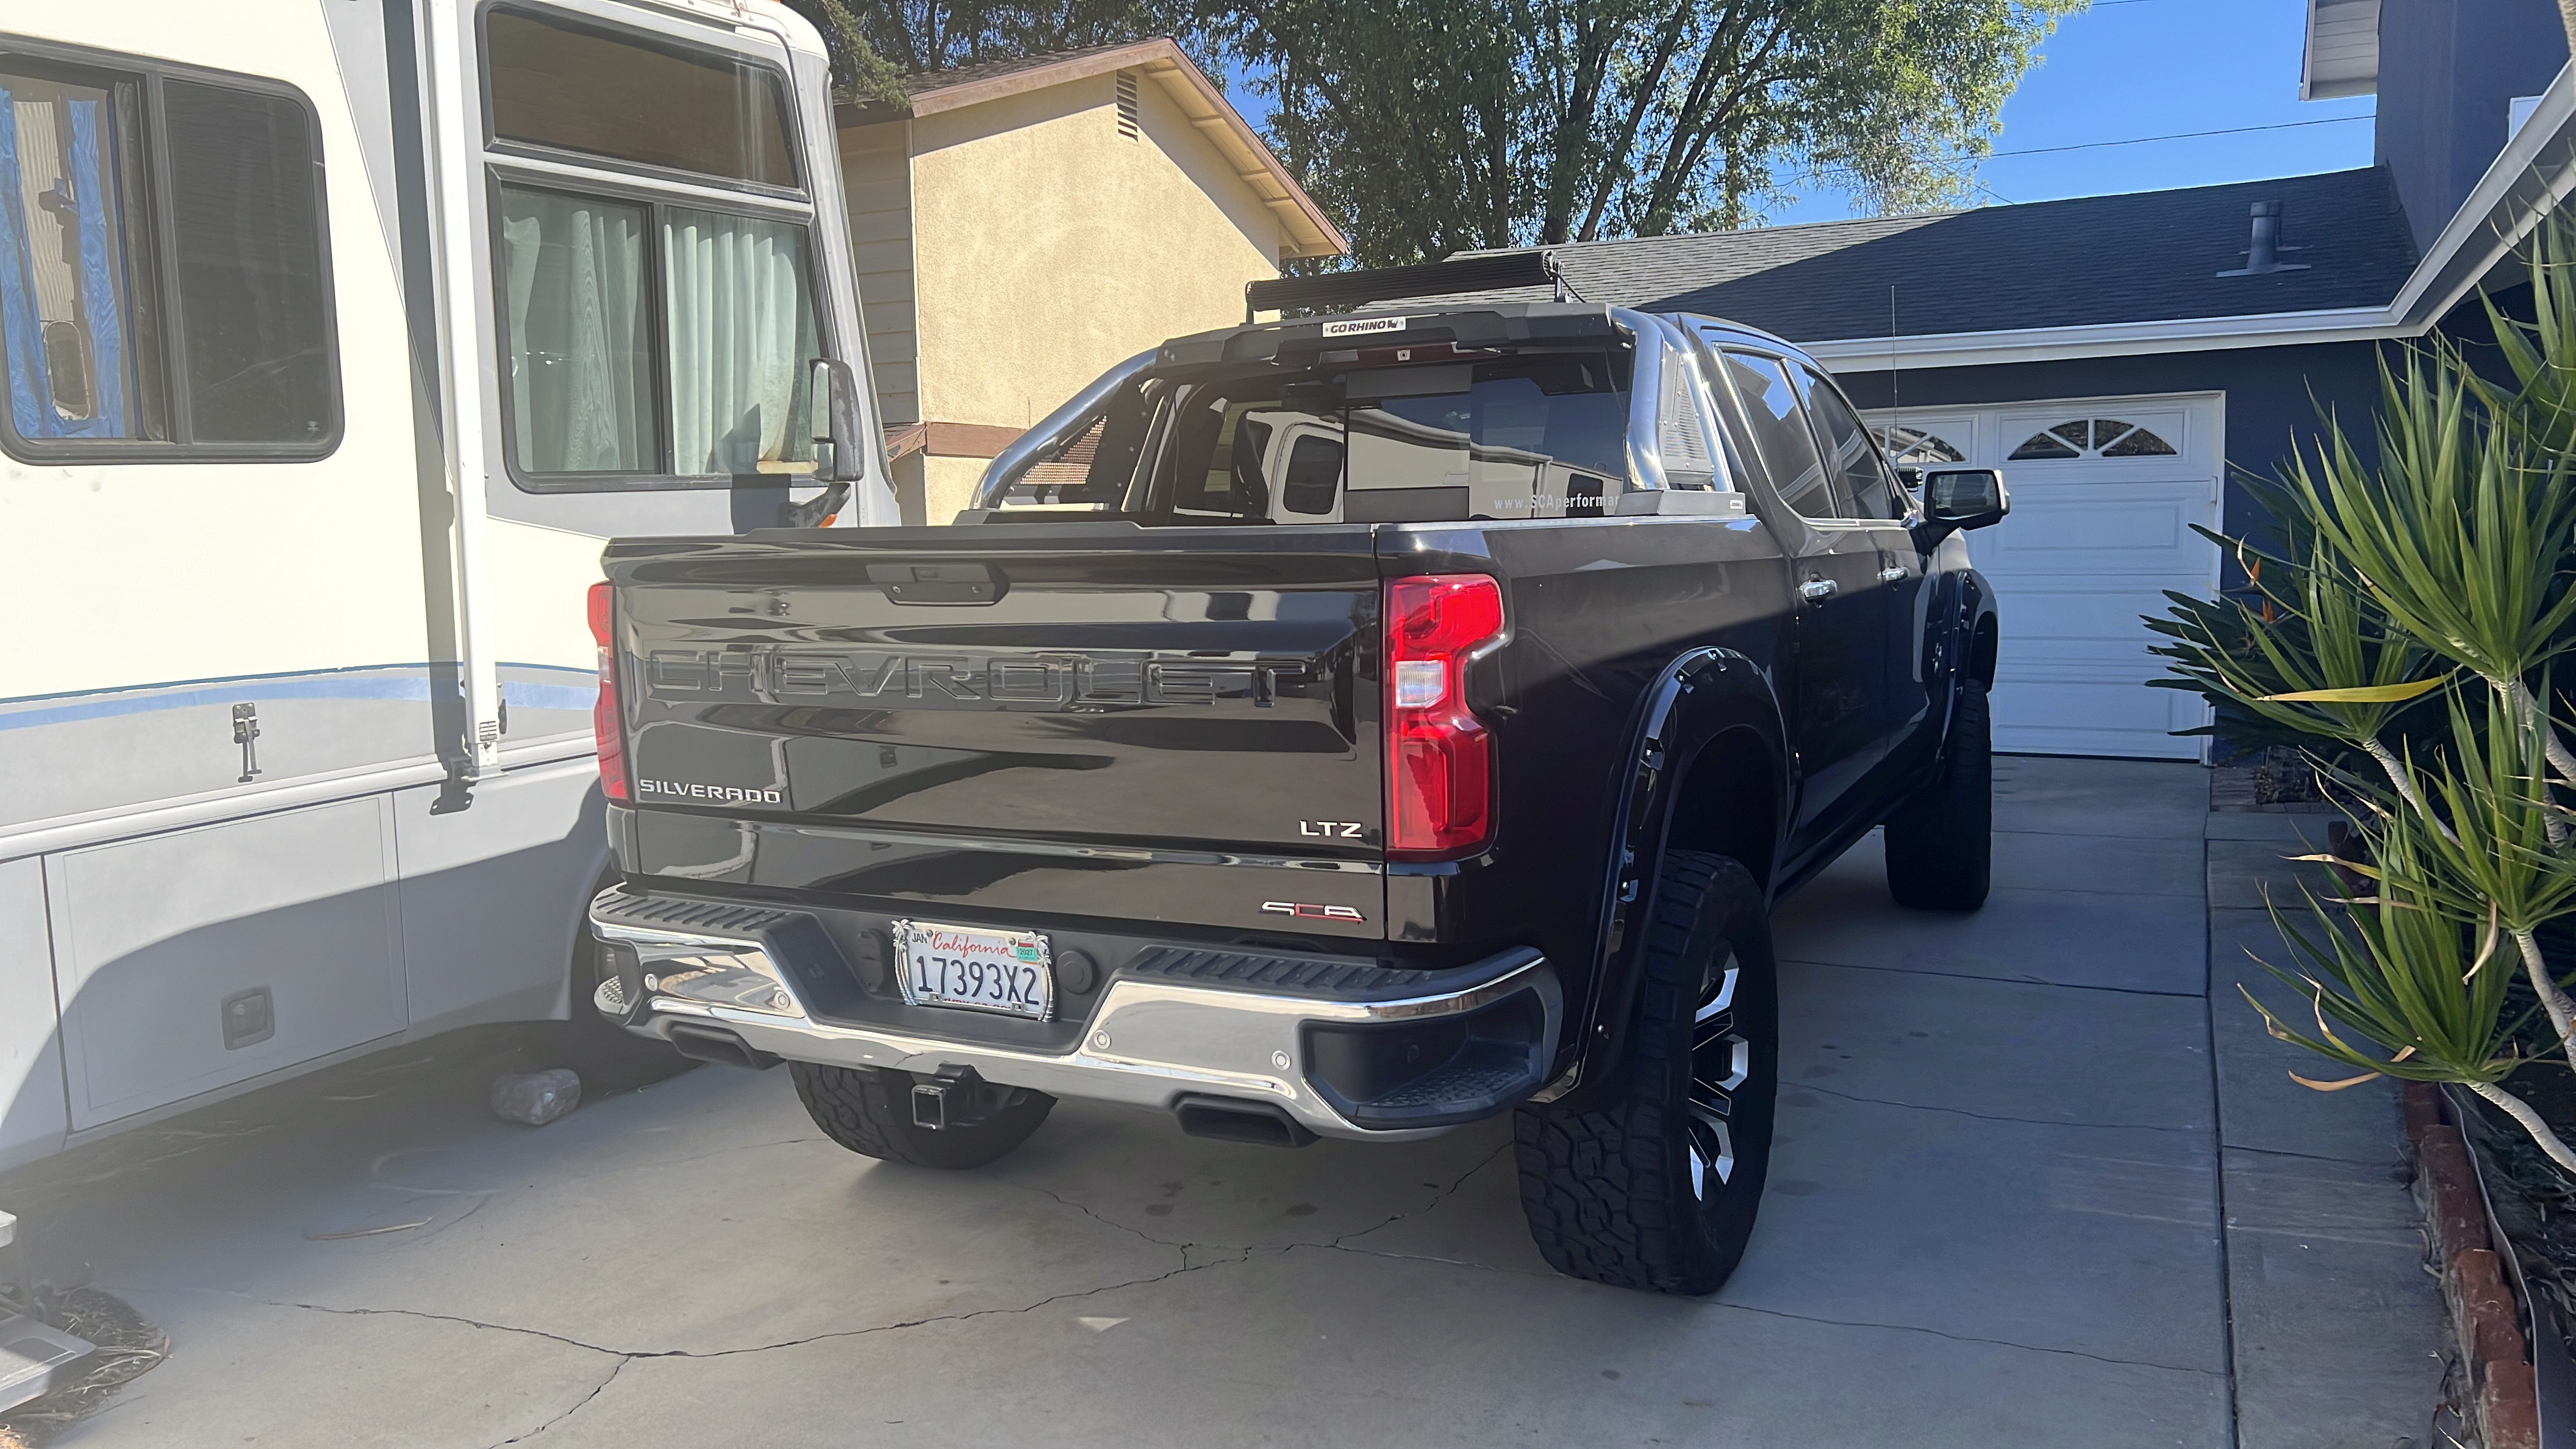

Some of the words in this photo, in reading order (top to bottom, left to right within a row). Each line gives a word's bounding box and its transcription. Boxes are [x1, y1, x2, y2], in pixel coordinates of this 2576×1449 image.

[650, 649, 1306, 707] CHEVROLET
[640, 779, 781, 803] SILVERADO
[1300, 820, 1362, 837] LTZ
[912, 932, 927, 943] JAN
[932, 932, 1017, 958] California
[917, 955, 1039, 1005] 17393X2
